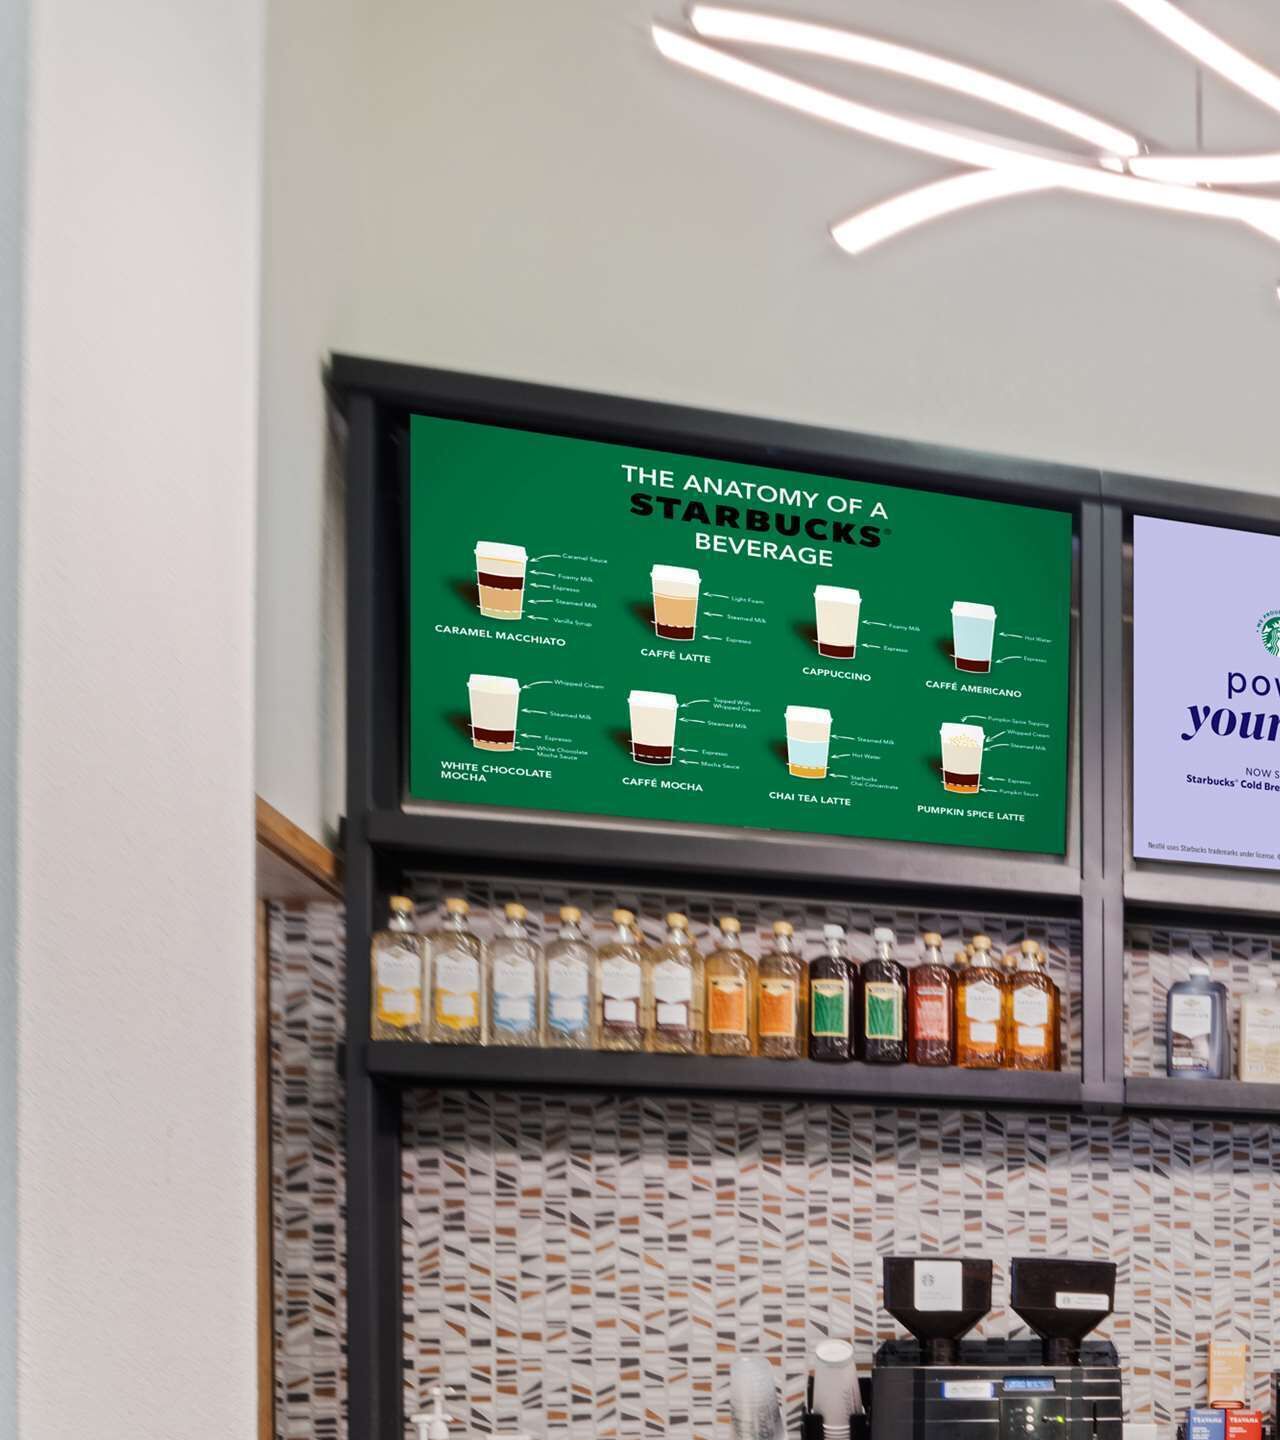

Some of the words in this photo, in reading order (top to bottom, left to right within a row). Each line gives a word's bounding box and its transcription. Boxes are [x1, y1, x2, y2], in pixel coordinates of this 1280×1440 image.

[621, 464, 675, 489] THE
[683, 474, 819, 509] ANATOMY
[827, 495, 863, 515] OF
[870, 502, 888, 520] A
[695, 532, 833, 567] BEVERAGE
[435, 624, 492, 639] CARAMEL
[495, 631, 566, 647] MACCHIATO
[640, 648, 676, 660] CAFFÉ
[679, 653, 711, 664] LATTE
[802, 667, 871, 681] CAPPUCCINO
[925, 680, 958, 691] CAFFÉ
[960, 684, 1022, 698] AMERICANO
[440, 760, 479, 772] WHITE
[481, 765, 552, 778] CHOCOLATE
[440, 771, 487, 782] MOCHA
[1245, 767, 1271, 778] NOW
[622, 777, 657, 788] CAFFÉ
[660, 780, 704, 792] MOCHA
[1240, 779, 1262, 790] Cold
[768, 791, 795, 801] CHAI
[797, 793, 817, 803] TEA
[820, 796, 852, 806] LATTE
[917, 804, 965, 818] PUMPKIN
[966, 809, 994, 820] SPICE
[997, 812, 1025, 823] LATTE
[1180, 844, 1207, 854] Starbucks
[1207, 847, 1238, 857] trademarks
